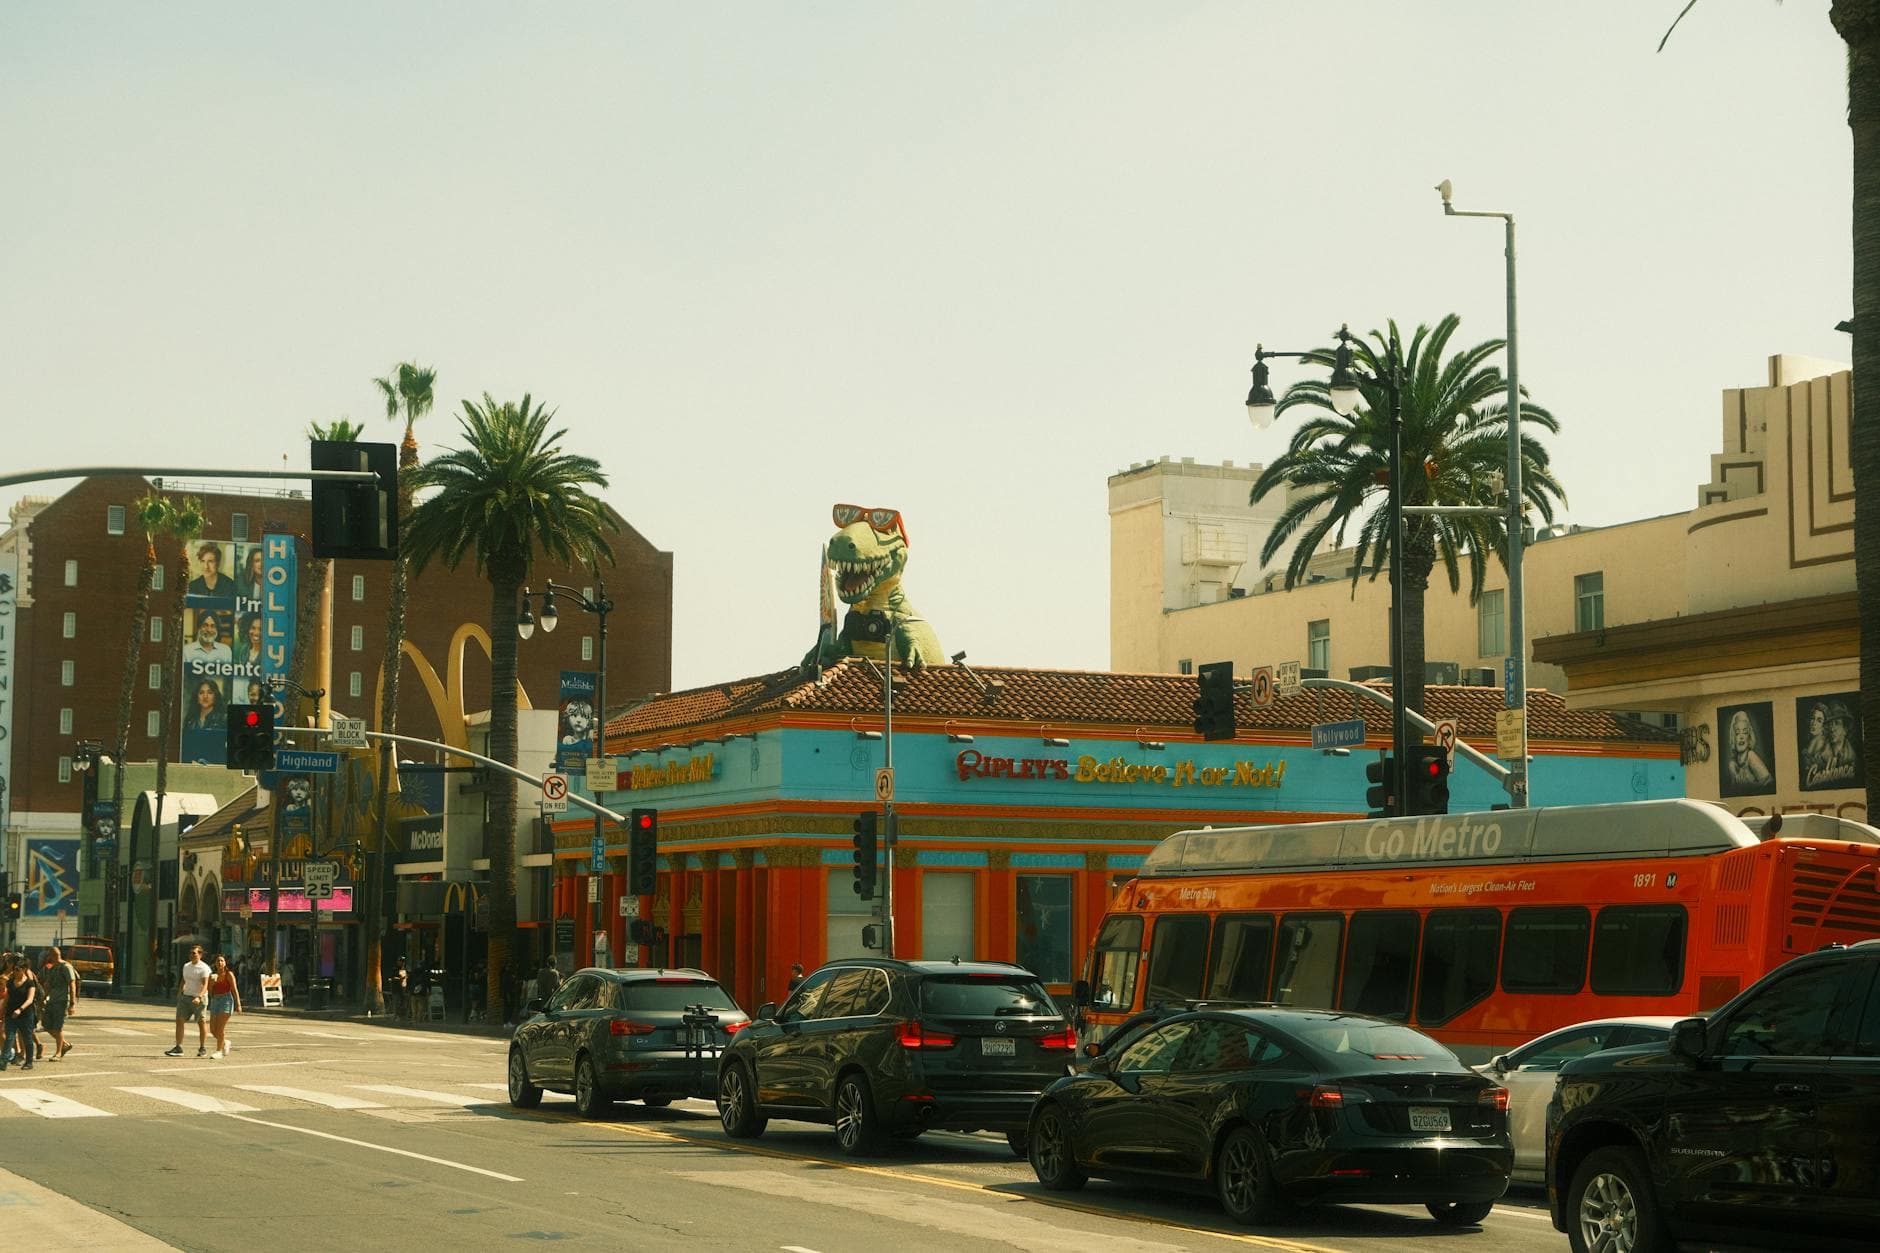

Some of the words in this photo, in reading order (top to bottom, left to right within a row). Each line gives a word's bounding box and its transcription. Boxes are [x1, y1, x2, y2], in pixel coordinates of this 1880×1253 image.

[337, 722, 346, 730] DO
[349, 722, 361, 730] NOT
[338, 730, 360, 738] BLOCK
[1317, 728, 1359, 745] Hollywood
[282, 754, 332, 769] Highland
[1074, 754, 1168, 784] Believe
[1172, 759, 1196, 788] It
[1201, 766, 1228, 786] or
[1232, 759, 1286, 789] Not!
[1364, 820, 1405, 860] Go
[1411, 816, 1502, 859] Metro
[1429, 883, 1457, 894] Nation's
[1458, 883, 1482, 895] Largest
[1517, 880, 1536, 891] Fleet
[1633, 873, 1657, 888] 1891
[307, 883, 331, 896] 25
[1179, 887, 1201, 900] Metro
[1202, 887, 1217, 900] Bus
